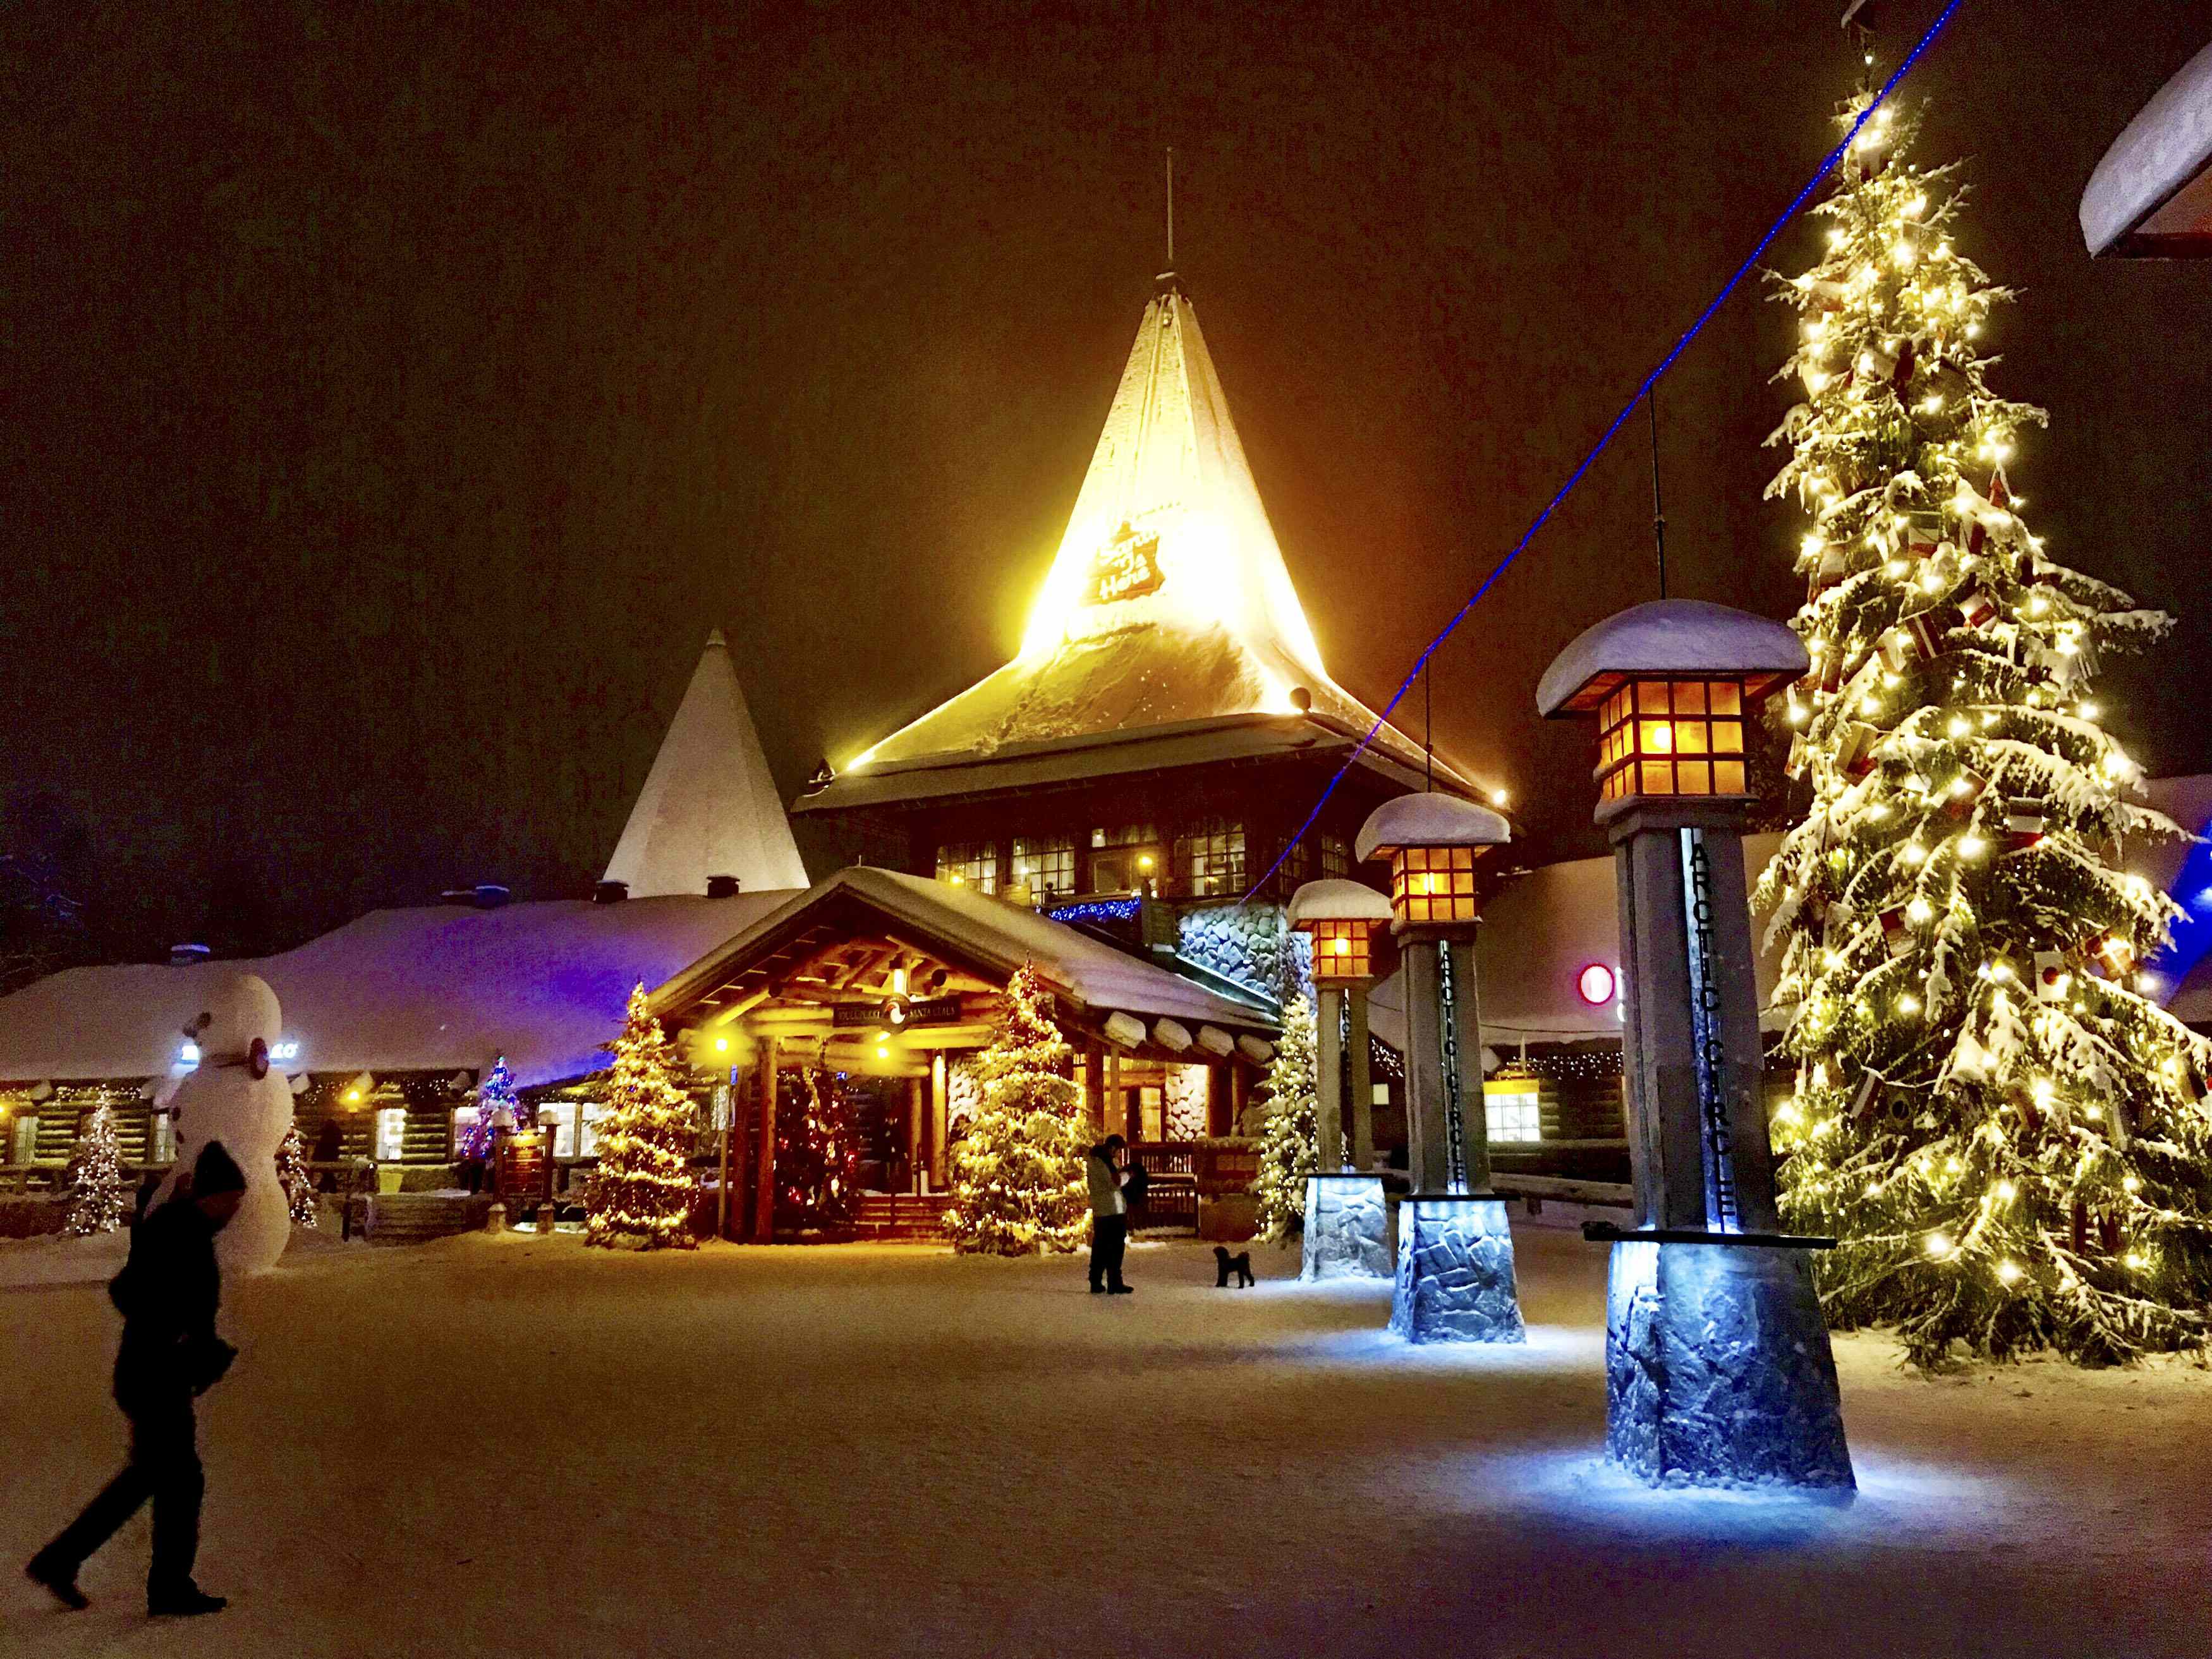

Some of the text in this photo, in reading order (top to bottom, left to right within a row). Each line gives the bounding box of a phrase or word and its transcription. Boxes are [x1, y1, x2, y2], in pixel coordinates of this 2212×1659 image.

[1441, 951, 1457, 1055] ARCTIC
[1689, 842, 1735, 1217] ARCTIC CIRCLE
